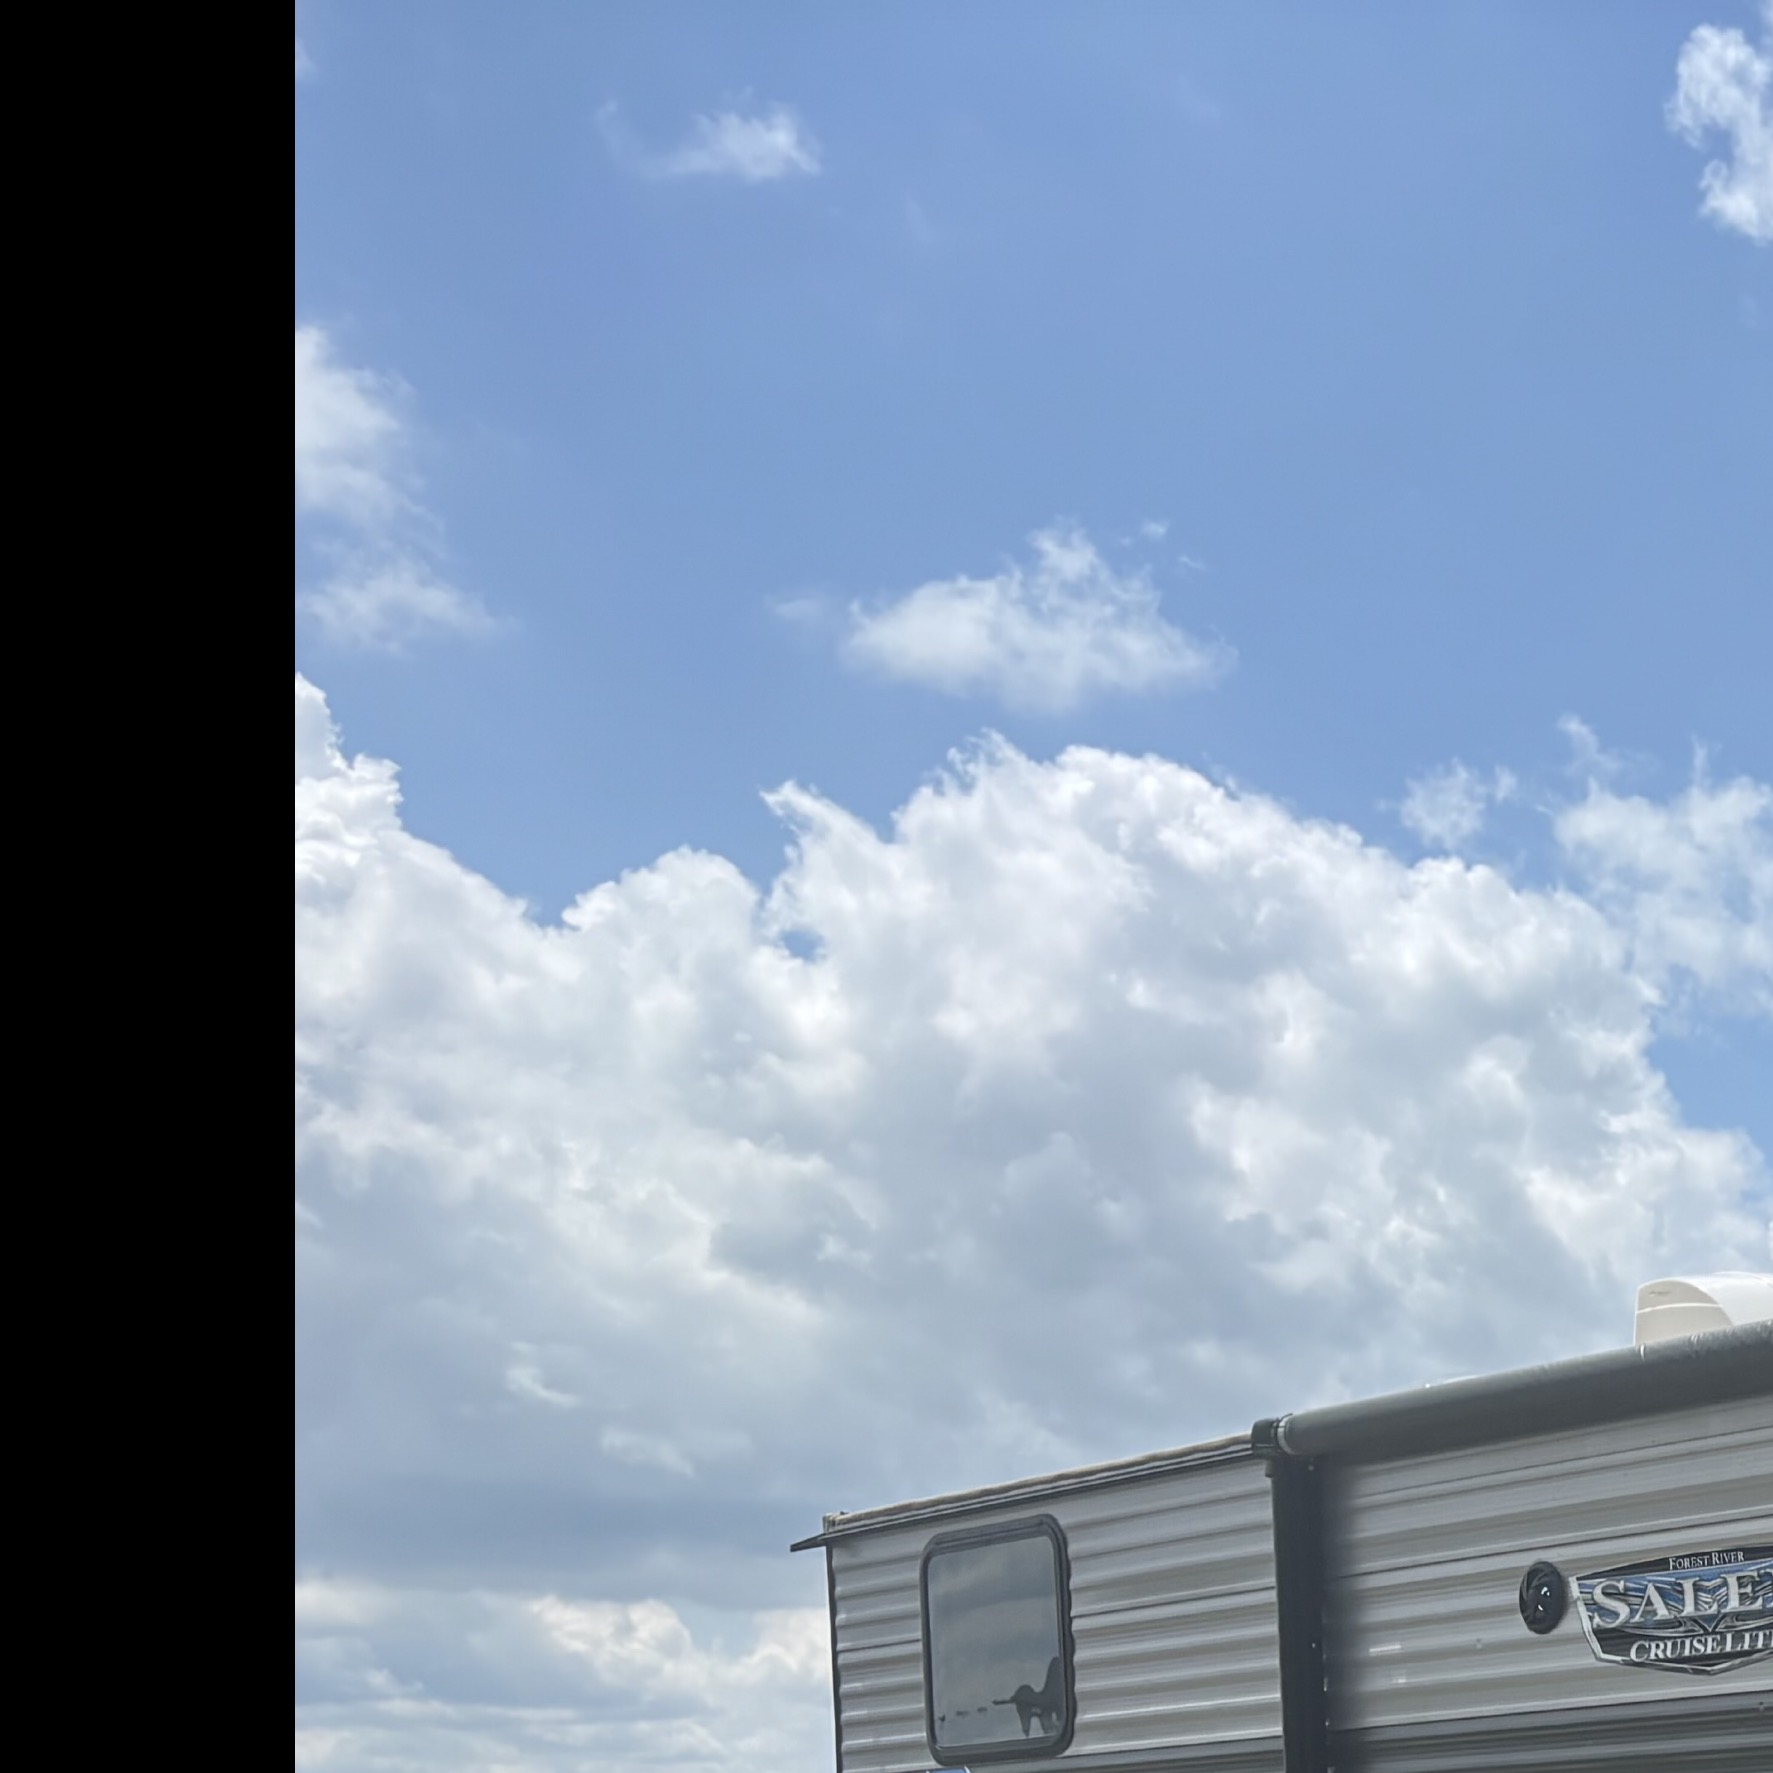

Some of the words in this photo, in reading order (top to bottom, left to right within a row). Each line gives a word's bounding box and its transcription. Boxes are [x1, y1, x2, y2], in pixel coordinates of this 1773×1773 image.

[1668, 1556, 1710, 1571] FOREST
[1711, 1550, 1745, 1566] RIVER
[1629, 1635, 1722, 1663] CRUISE
